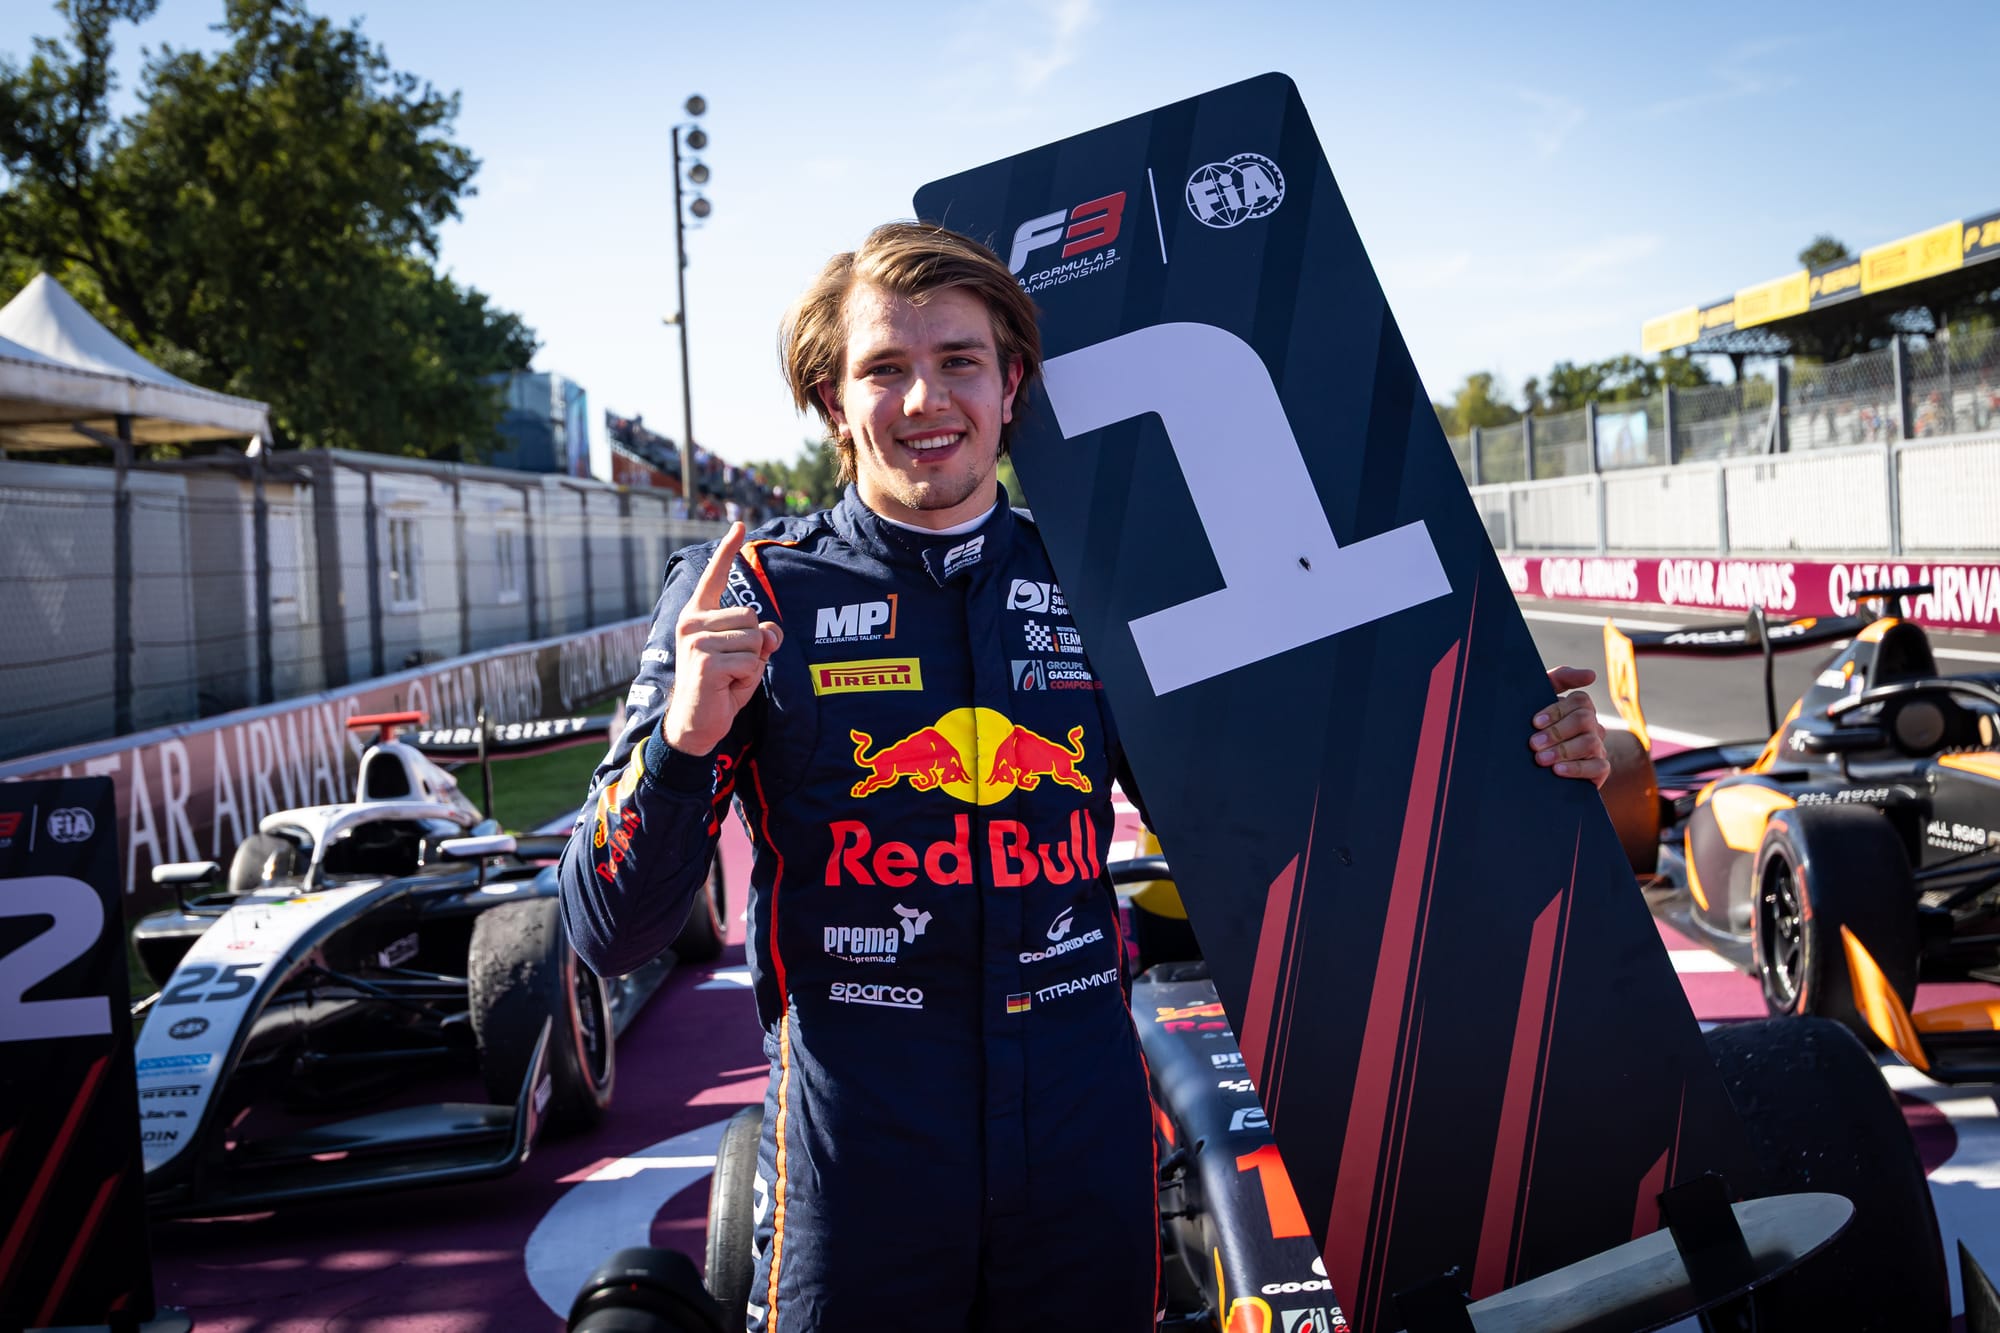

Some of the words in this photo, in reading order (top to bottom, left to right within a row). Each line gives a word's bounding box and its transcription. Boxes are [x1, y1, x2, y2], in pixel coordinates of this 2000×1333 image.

[1008, 191, 1127, 276] F3
[1029, 252, 1104, 284] FORMULA
[1106, 248, 1116, 260] 3
[1041, 321, 1454, 698] 1
[1658, 559, 1715, 605] QATAR
[1715, 561, 1797, 611] AIRWAYS
[1914, 565, 2000, 625] AIRWA
[815, 635, 858, 645] ACCELERATING
[860, 634, 881, 642] TALENT
[819, 664, 912, 689] PIRELLI
[1046, 661, 1084, 671] GROUPE
[825, 813, 974, 888] Red
[988, 808, 1101, 888] Bull
[0, 875, 113, 1043] 2
[823, 926, 900, 954] prema
[1019, 928, 1104, 964] GOODRIDGE
[159, 962, 263, 1007] 25
[829, 982, 924, 1009] sparco
